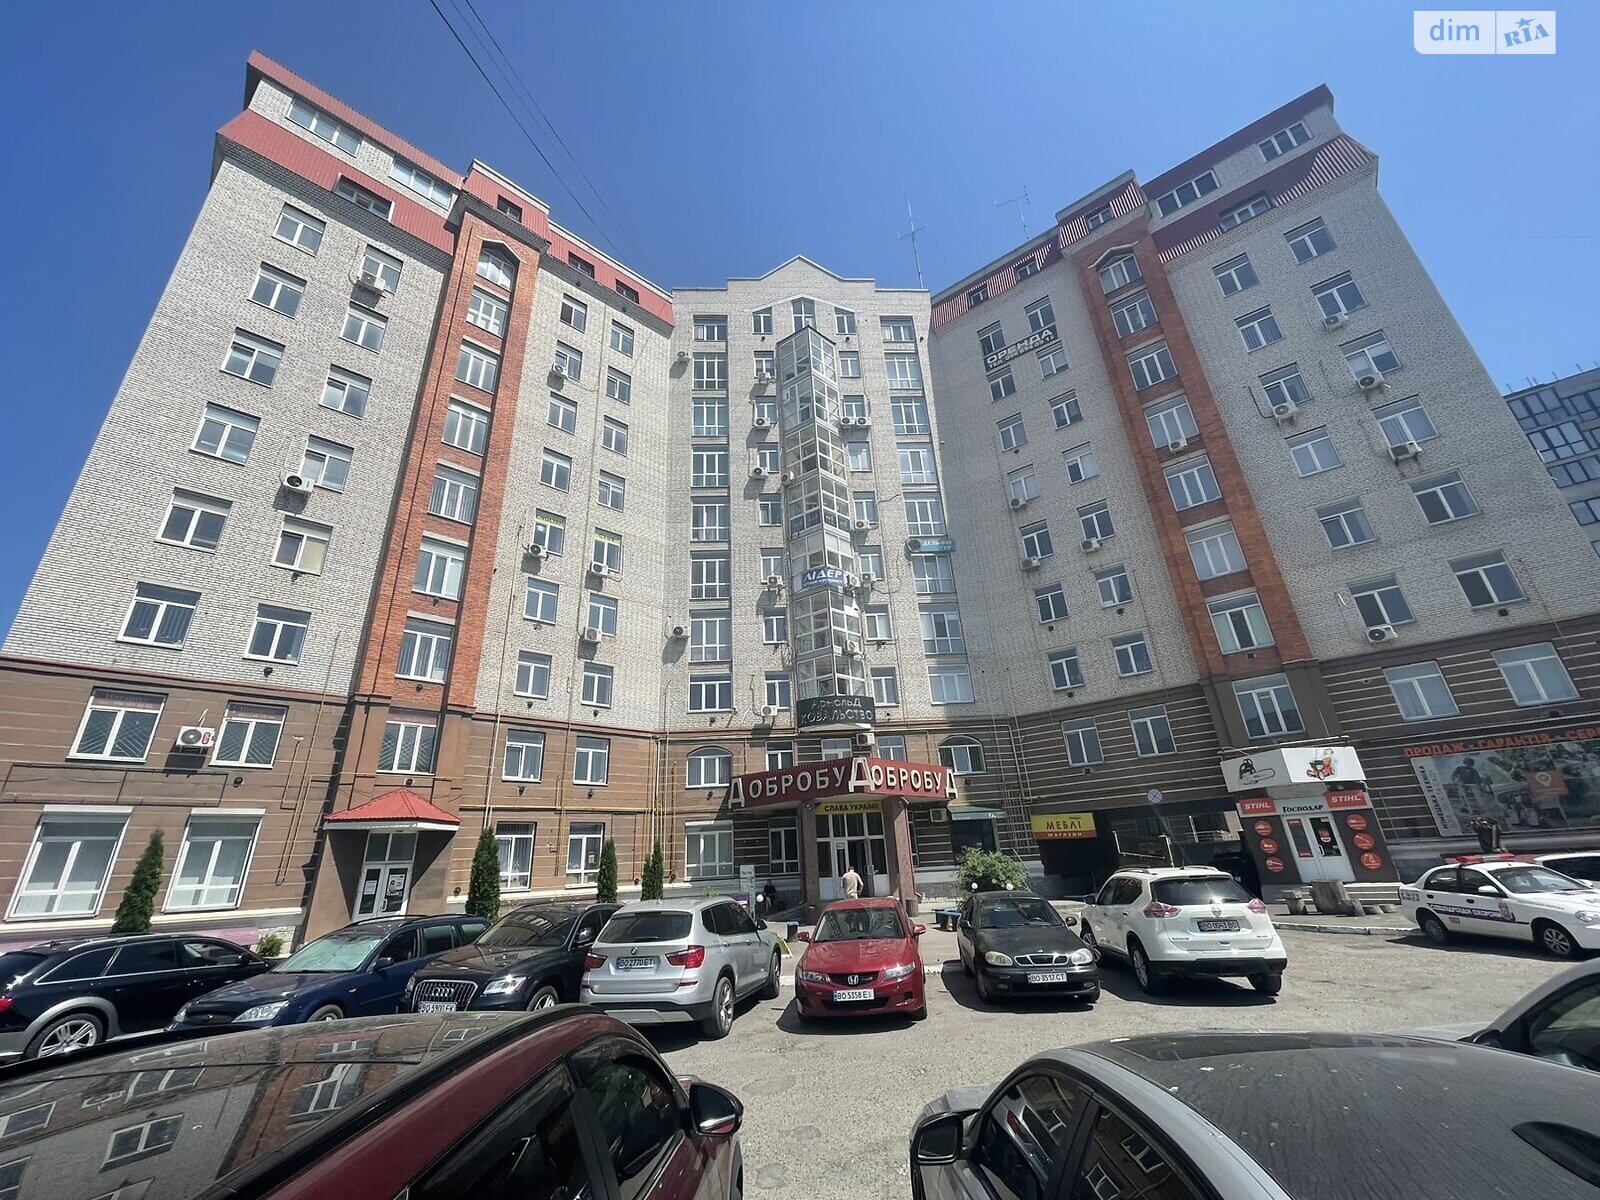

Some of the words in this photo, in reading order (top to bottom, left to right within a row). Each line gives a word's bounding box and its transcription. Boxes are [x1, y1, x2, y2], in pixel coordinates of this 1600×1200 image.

[986, 329, 1053, 364] ОРЕНДА
[1404, 742, 1464, 758] ПРОДАЖ
[1478, 733, 1551, 749] ГАРАНТІЯ
[848, 756, 958, 800] ДОБРОБУД
[1244, 802, 1271, 810] STIHL
[1330, 794, 1361, 803] STIHL
[1046, 820, 1081, 830] МЕБЛІ
